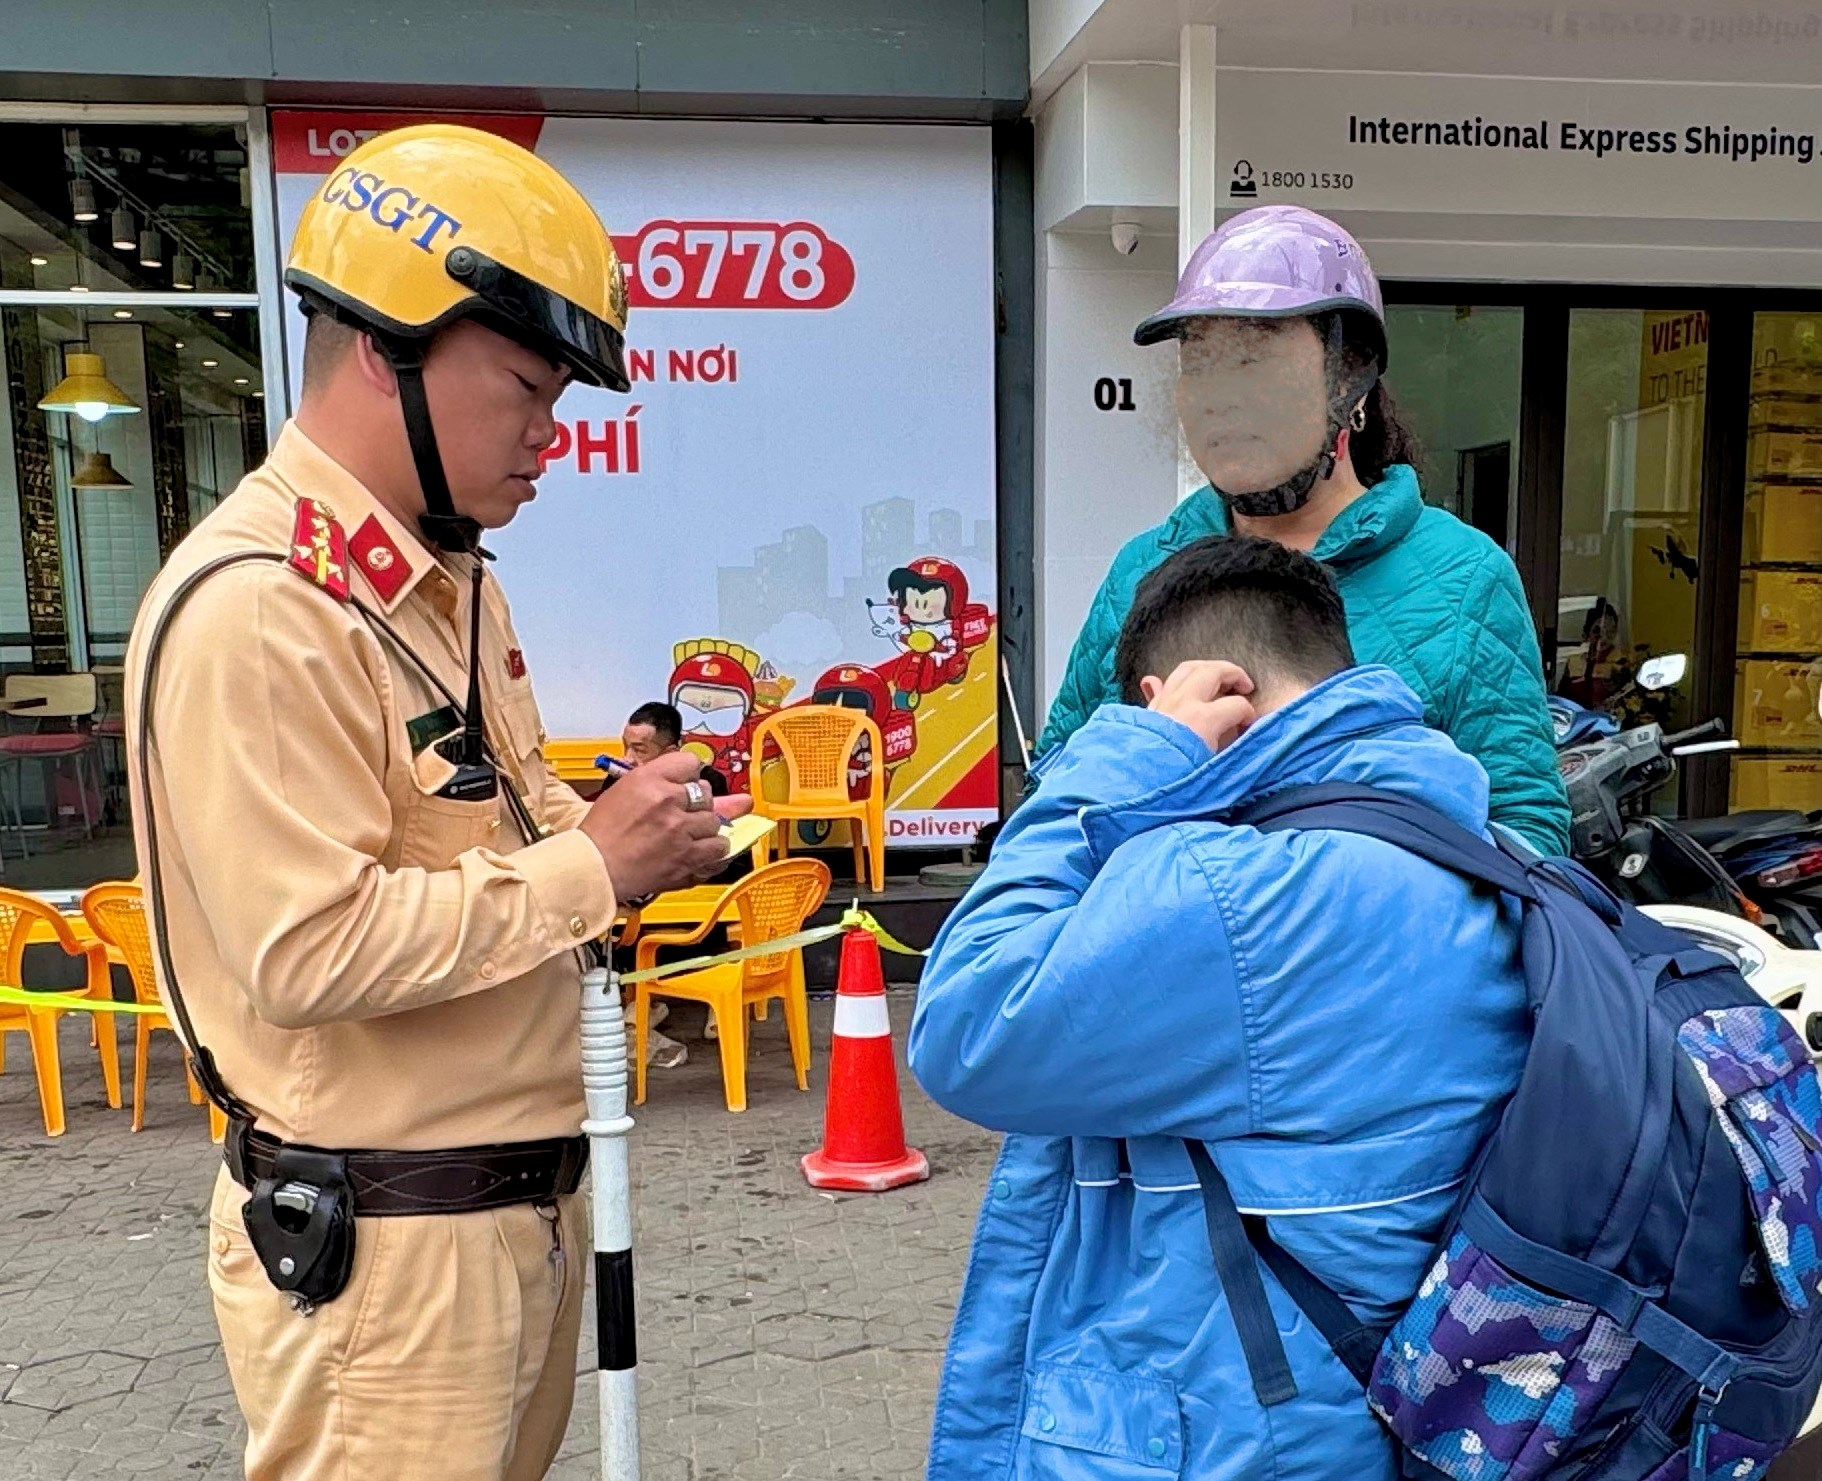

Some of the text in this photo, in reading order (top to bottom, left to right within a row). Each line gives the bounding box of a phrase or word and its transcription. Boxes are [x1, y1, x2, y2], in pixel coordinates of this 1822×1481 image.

[1349, 115, 1814, 164] International Express Shipping
[1261, 171, 1354, 190] 1800 1530
[323, 167, 462, 254] CSGT
[668, 342, 738, 382] NƠI
[1094, 377, 1137, 411] 01
[1649, 364, 1706, 403] TO THE
[536, 404, 644, 473] PHÍ
